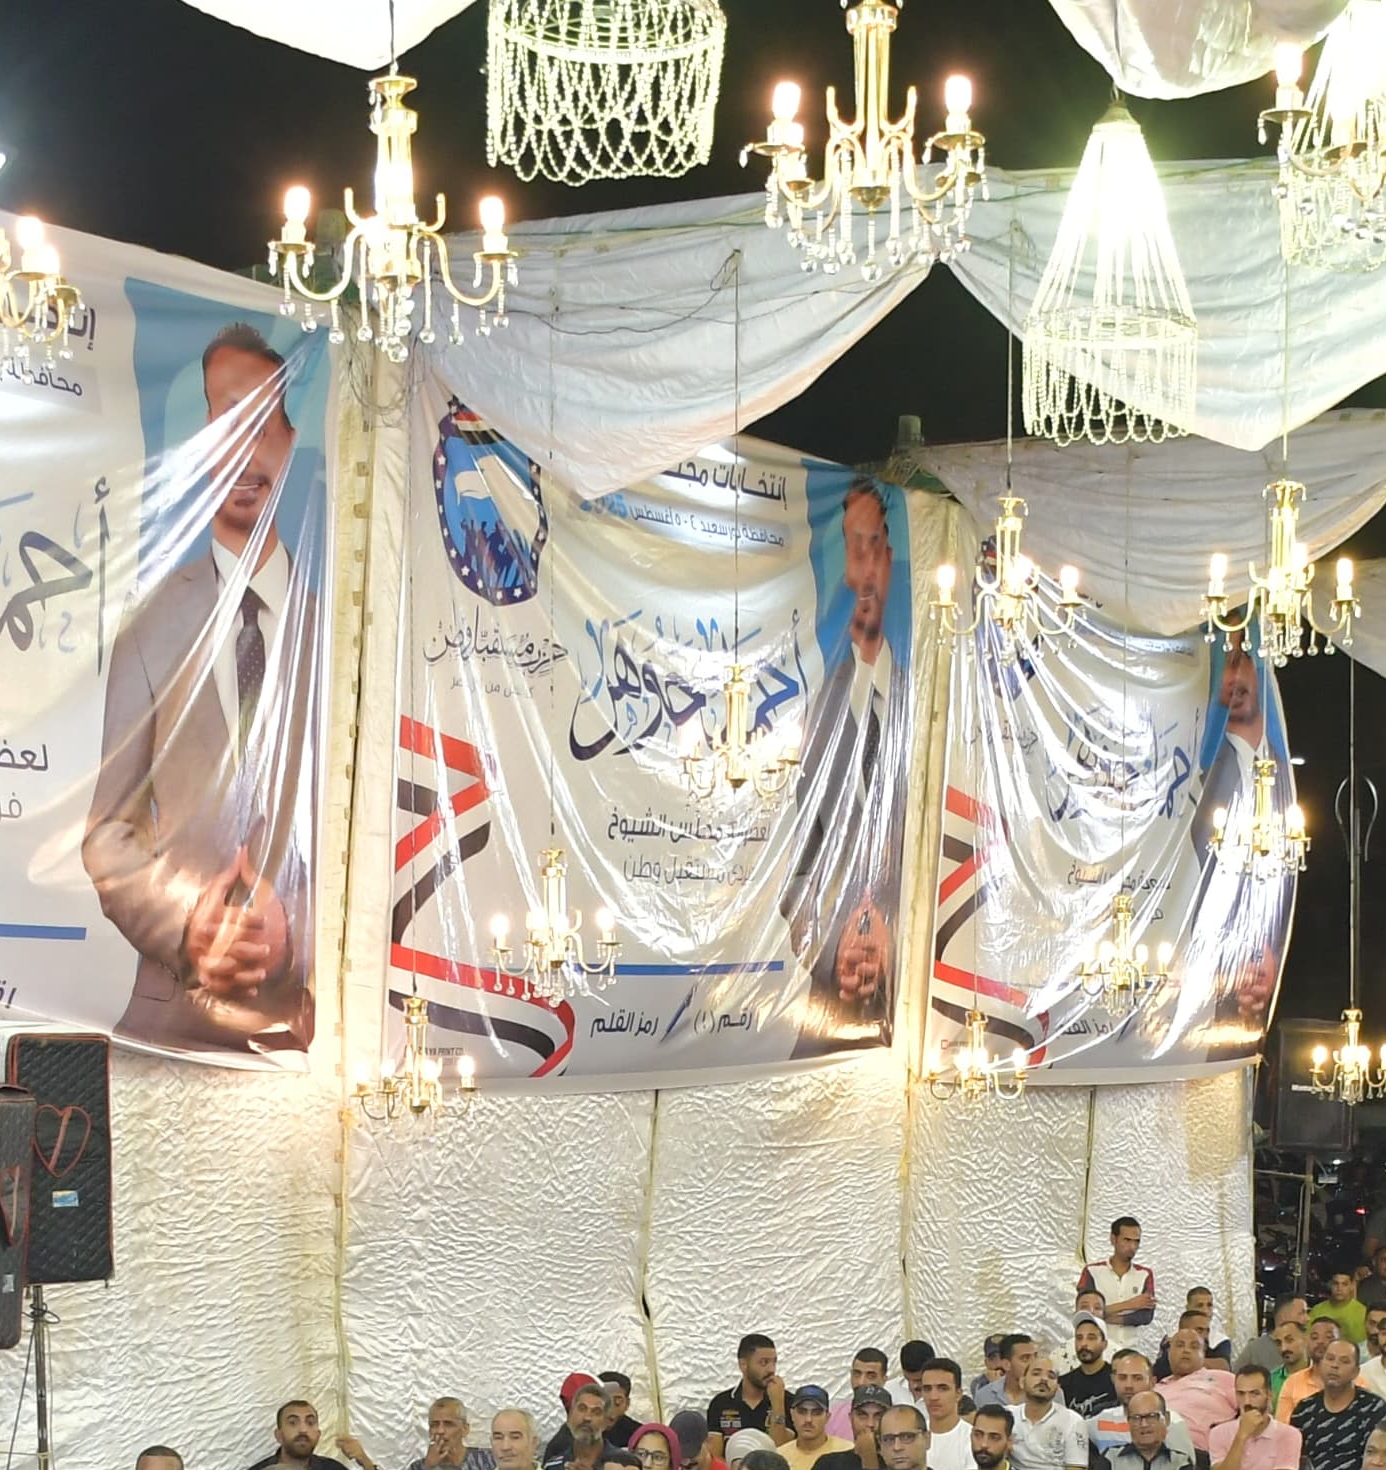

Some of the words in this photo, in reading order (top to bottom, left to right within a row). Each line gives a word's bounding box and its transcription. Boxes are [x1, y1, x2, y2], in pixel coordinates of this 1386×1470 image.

[590, 1008, 636, 1038] القلم
[635, 1009, 659, 1036] رمز
[717, 1008, 753, 1033] رقم
